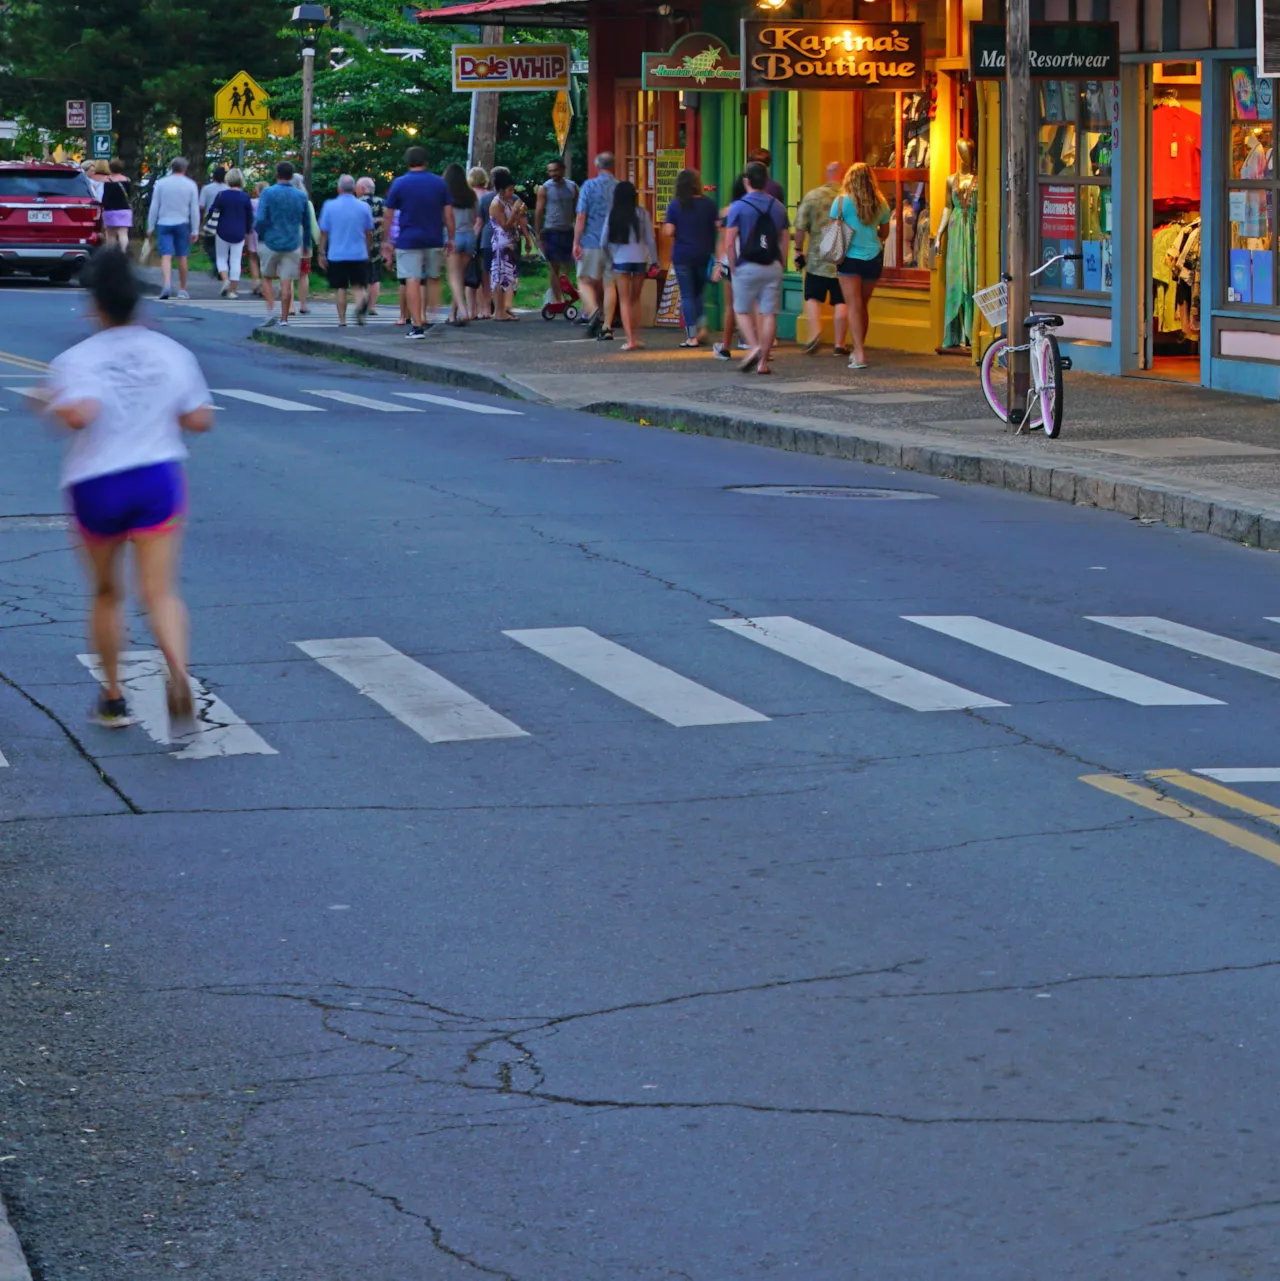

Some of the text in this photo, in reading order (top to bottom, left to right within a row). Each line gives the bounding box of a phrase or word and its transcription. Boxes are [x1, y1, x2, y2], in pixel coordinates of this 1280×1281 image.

[758, 28, 910, 58] Karina's
[461, 55, 508, 78] Dole
[751, 53, 915, 84] Boutique
[980, 50, 1110, 67] Ma Resortwear
[227, 127, 258, 135] AHEAD
